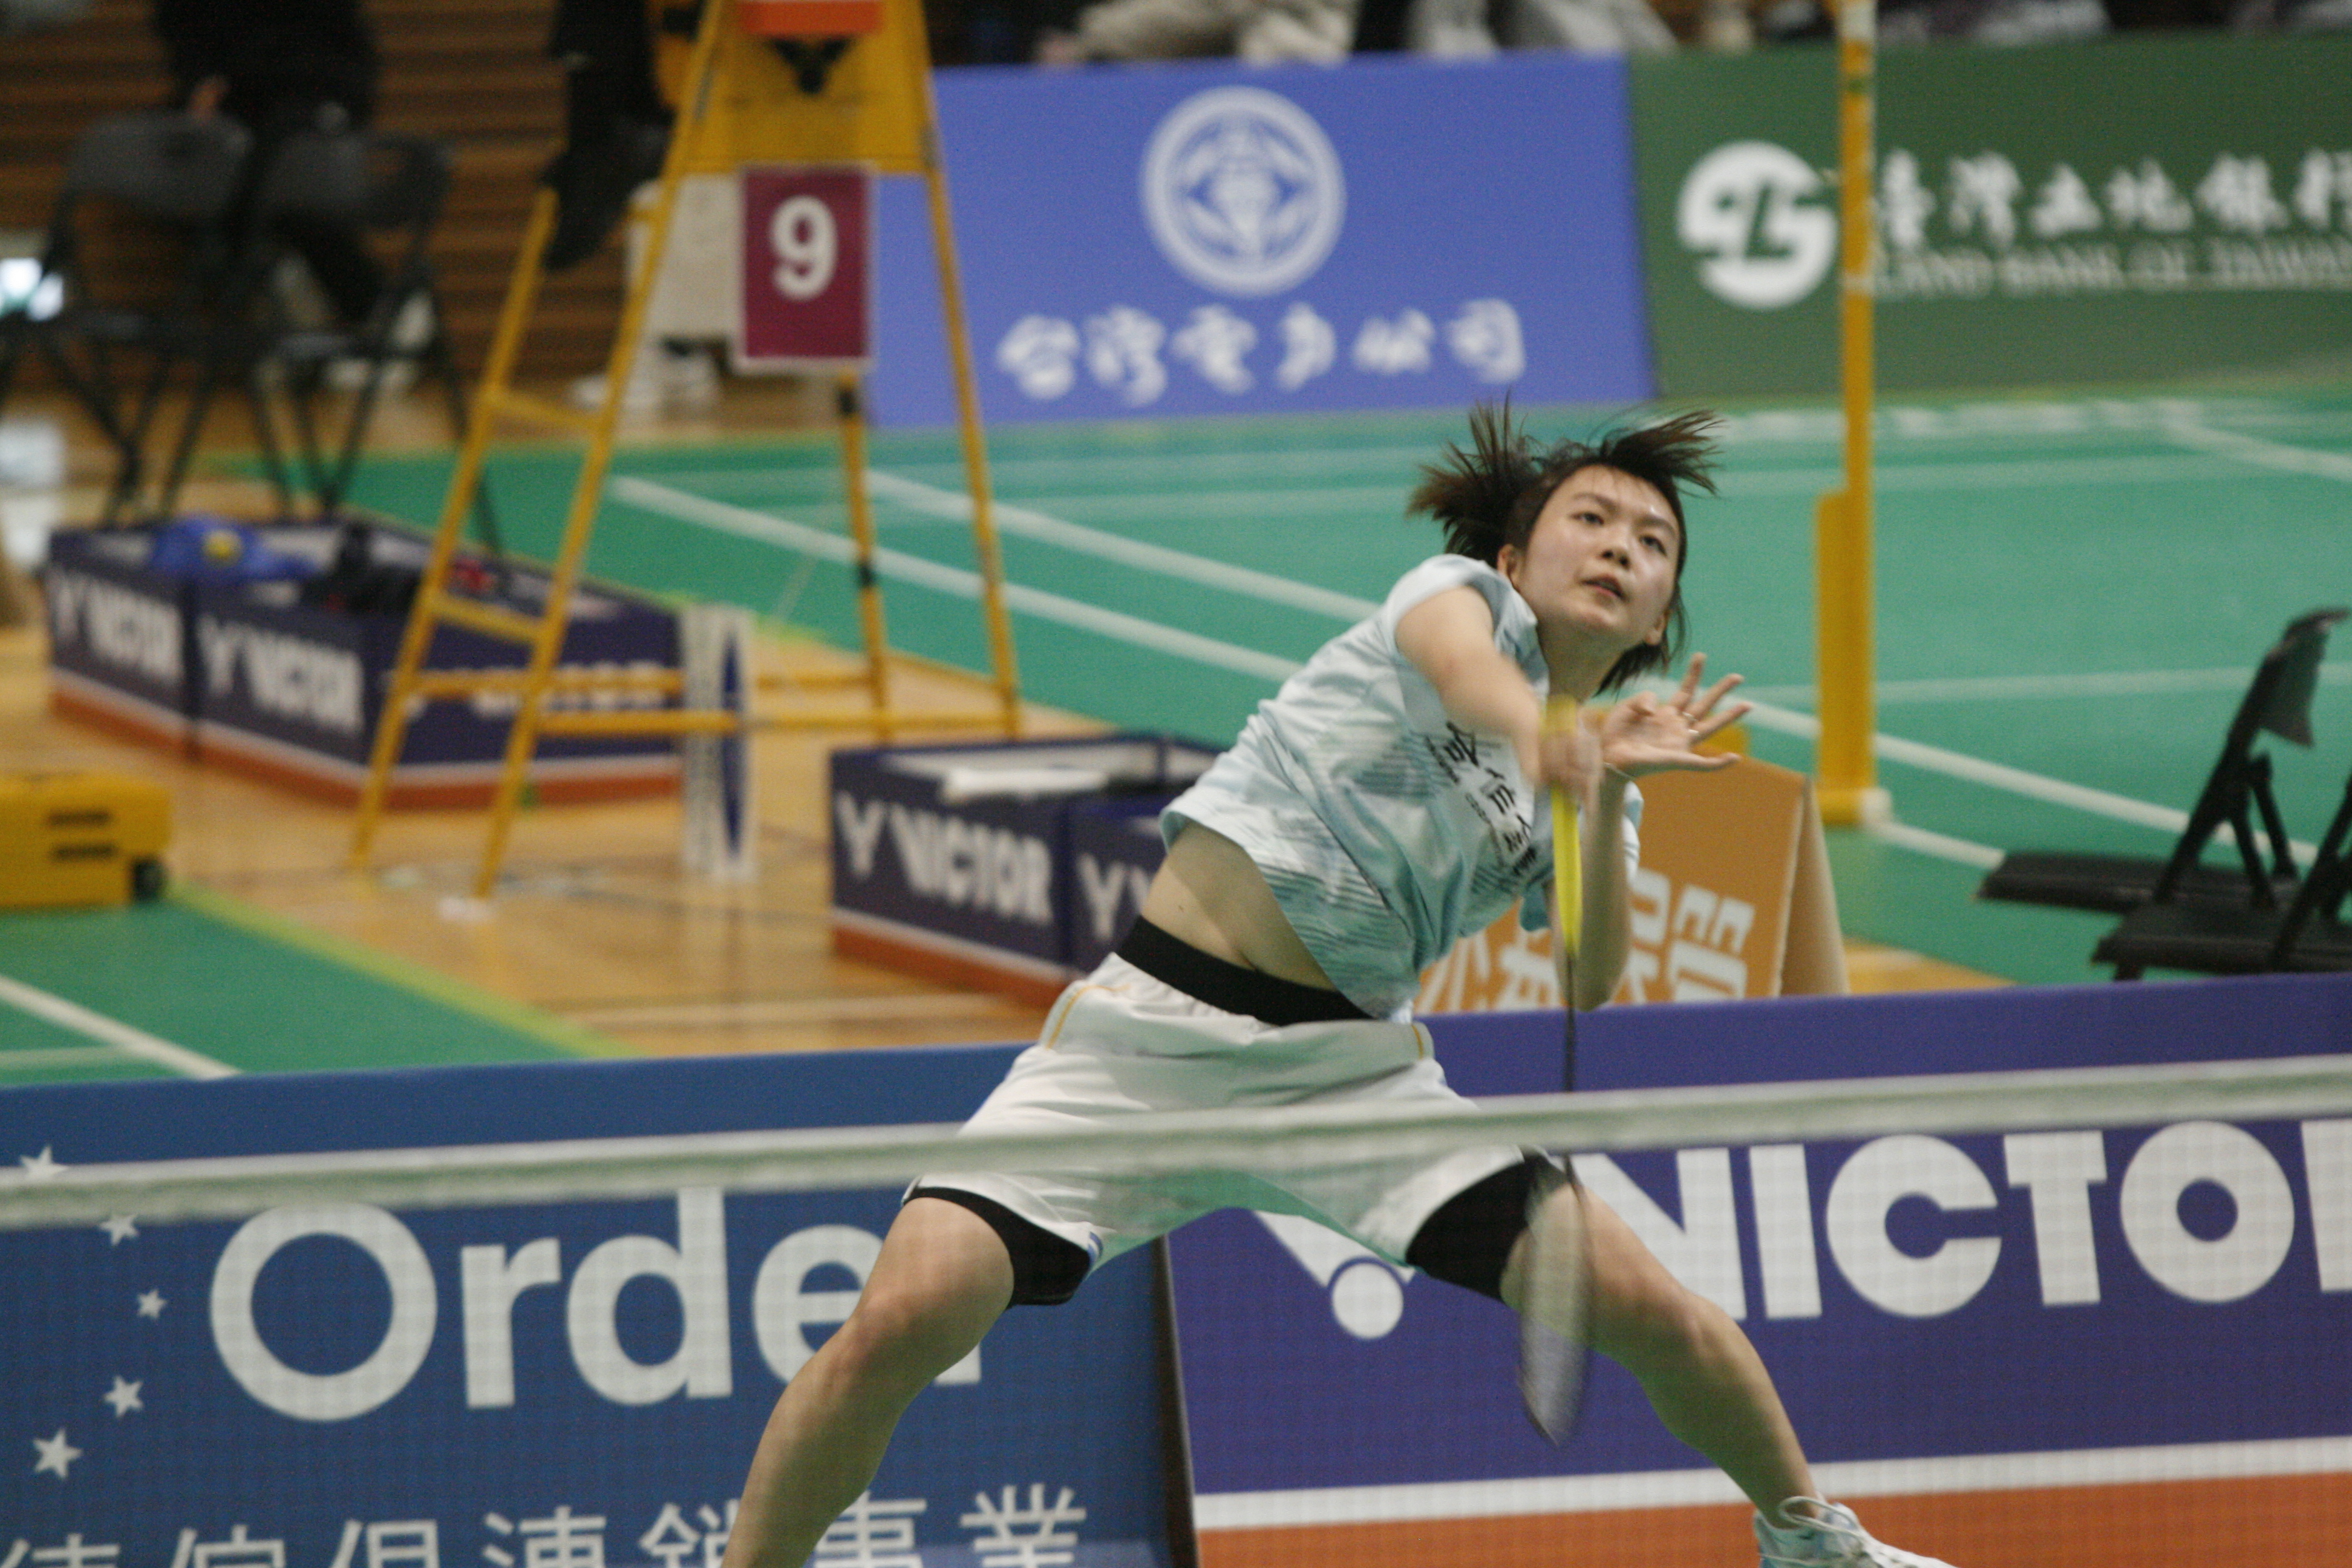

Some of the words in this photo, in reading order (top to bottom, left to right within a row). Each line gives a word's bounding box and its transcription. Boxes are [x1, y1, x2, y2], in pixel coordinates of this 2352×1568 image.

[771, 195, 837, 301] 9
[887, 800, 1054, 926] VICTOR
[1547, 1119, 2352, 1320] VICTO
[210, 1187, 981, 1422] Orde
